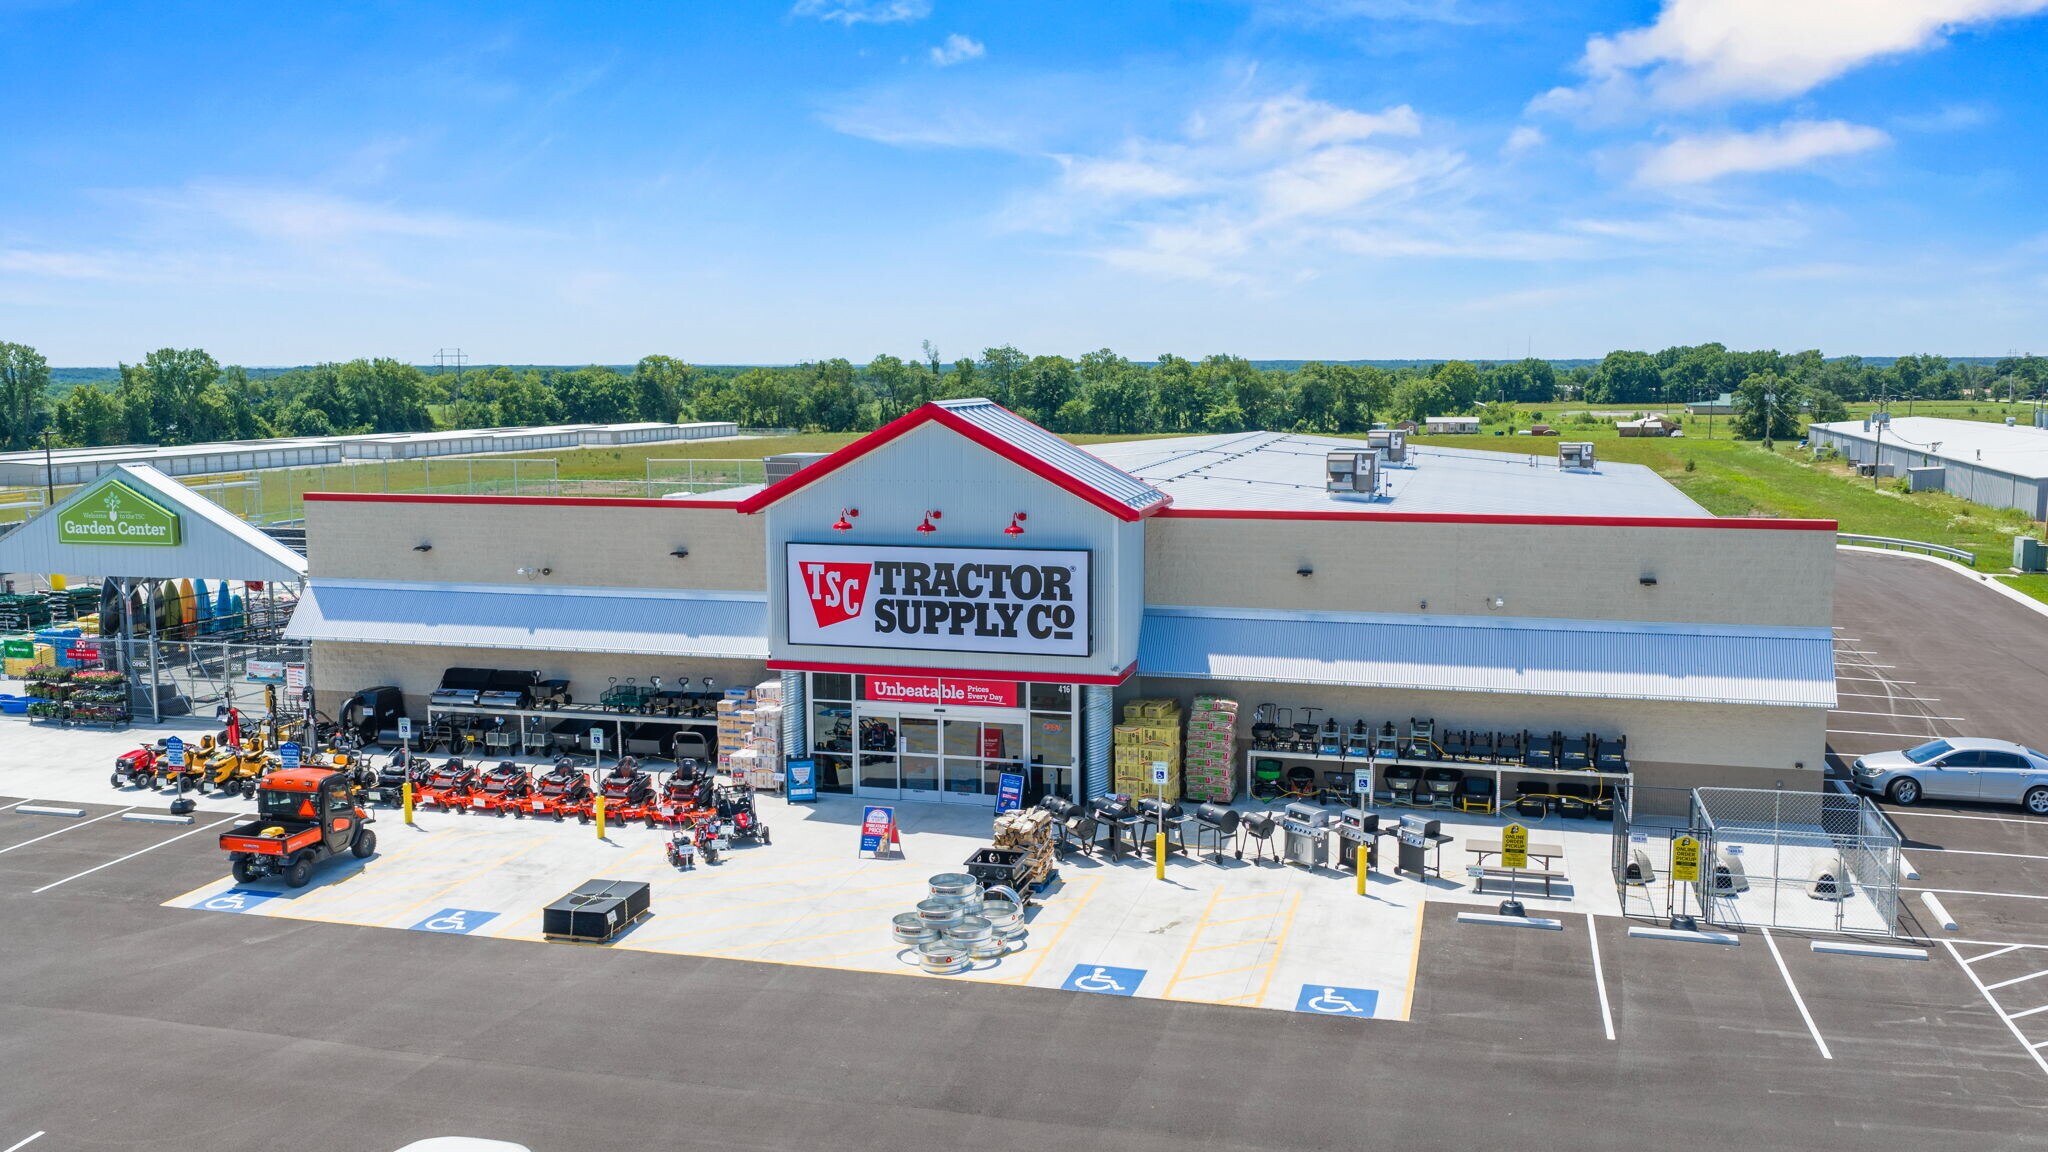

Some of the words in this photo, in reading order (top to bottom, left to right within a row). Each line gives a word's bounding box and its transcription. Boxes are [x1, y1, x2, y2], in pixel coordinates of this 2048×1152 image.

[64, 520, 116, 535] Garden
[117, 521, 167, 536] Center
[807, 563, 860, 616] TSC
[874, 560, 1073, 602] TRACTOR
[874, 598, 1024, 638] SUPPLY
[873, 681, 965, 699] Unbeatable
[967, 685, 989, 693] Prices
[967, 693, 988, 702] Every
[989, 693, 1003, 703] Day
[1058, 685, 1071, 693] 416
